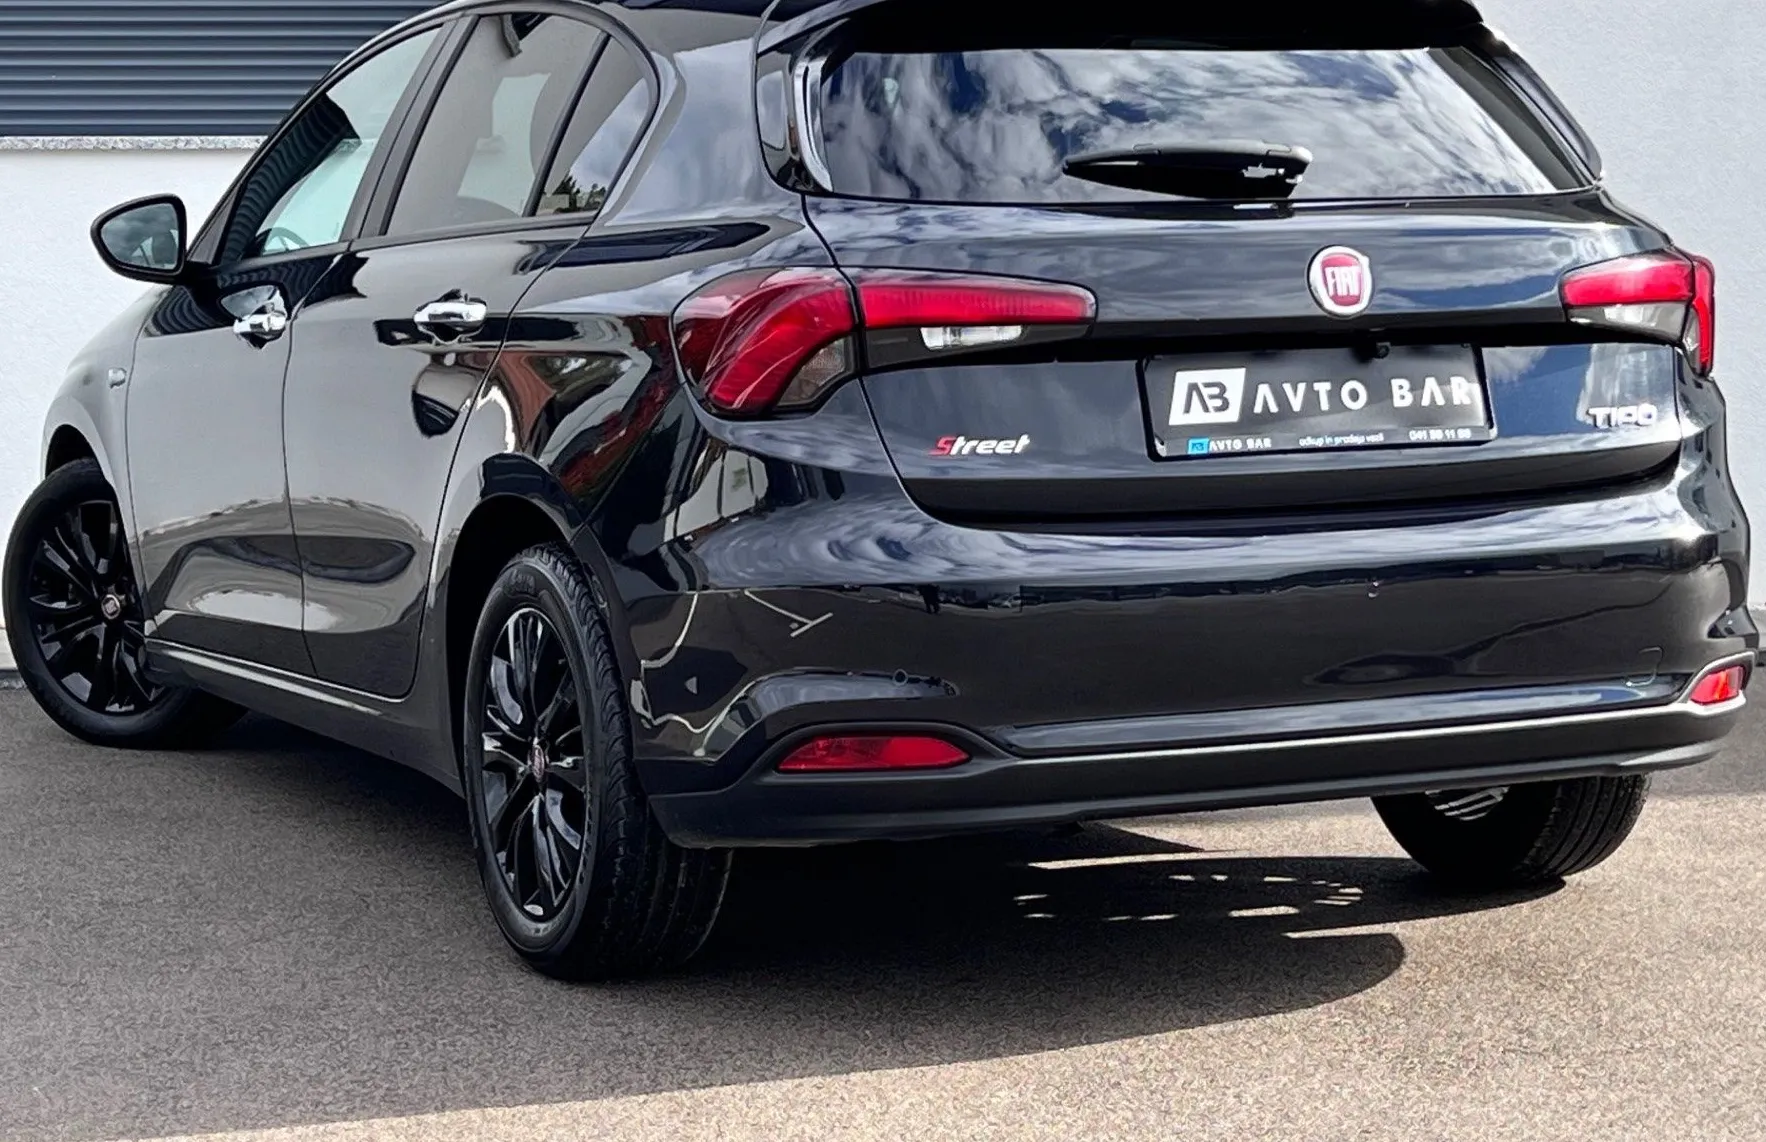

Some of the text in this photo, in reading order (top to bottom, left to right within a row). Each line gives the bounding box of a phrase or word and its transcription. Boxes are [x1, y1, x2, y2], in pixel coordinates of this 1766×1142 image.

[1323, 266, 1361, 297] FIAT
[1253, 379, 1368, 414] AVTO
[1390, 375, 1472, 408] BAR
[1588, 403, 1658, 430] TIPO
[928, 433, 1031, 456] Street
[1209, 439, 1243, 451] AVTO
[1246, 438, 1272, 449] BAR
